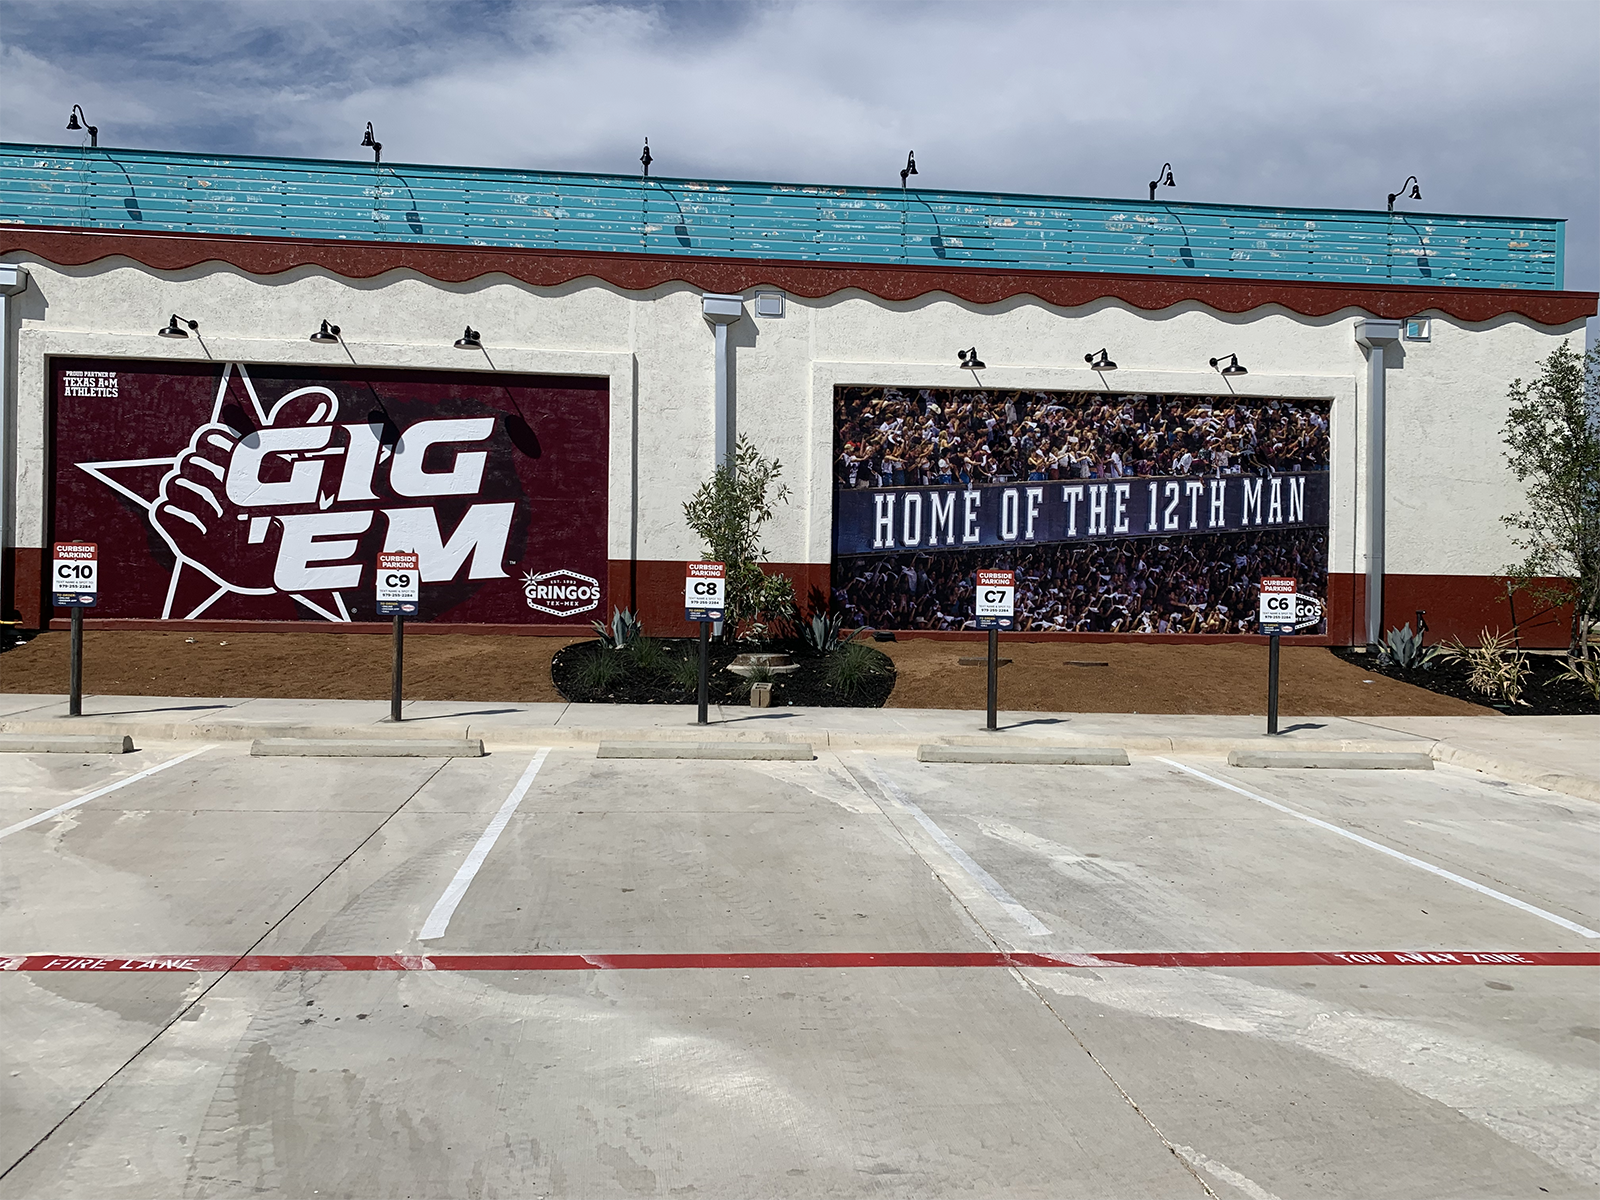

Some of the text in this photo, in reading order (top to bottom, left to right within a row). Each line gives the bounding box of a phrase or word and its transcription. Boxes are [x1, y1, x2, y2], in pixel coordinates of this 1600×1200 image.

[63, 377, 118, 388] TEXAS A&M
[64, 387, 118, 397] ATHLETICS
[226, 417, 495, 506] GIG
[872, 476, 1306, 549] HOME OF THE 12TH MAN
[58, 564, 93, 579] C10
[386, 574, 410, 588] C9
[525, 586, 600, 600] GRINGO'S
[694, 582, 717, 595] C8
[984, 590, 1006, 603] C7
[1267, 597, 1289, 610] C6
[43, 958, 200, 970] FIRE LANE
[1334, 954, 1534, 964] TOW AWAY ZONE
